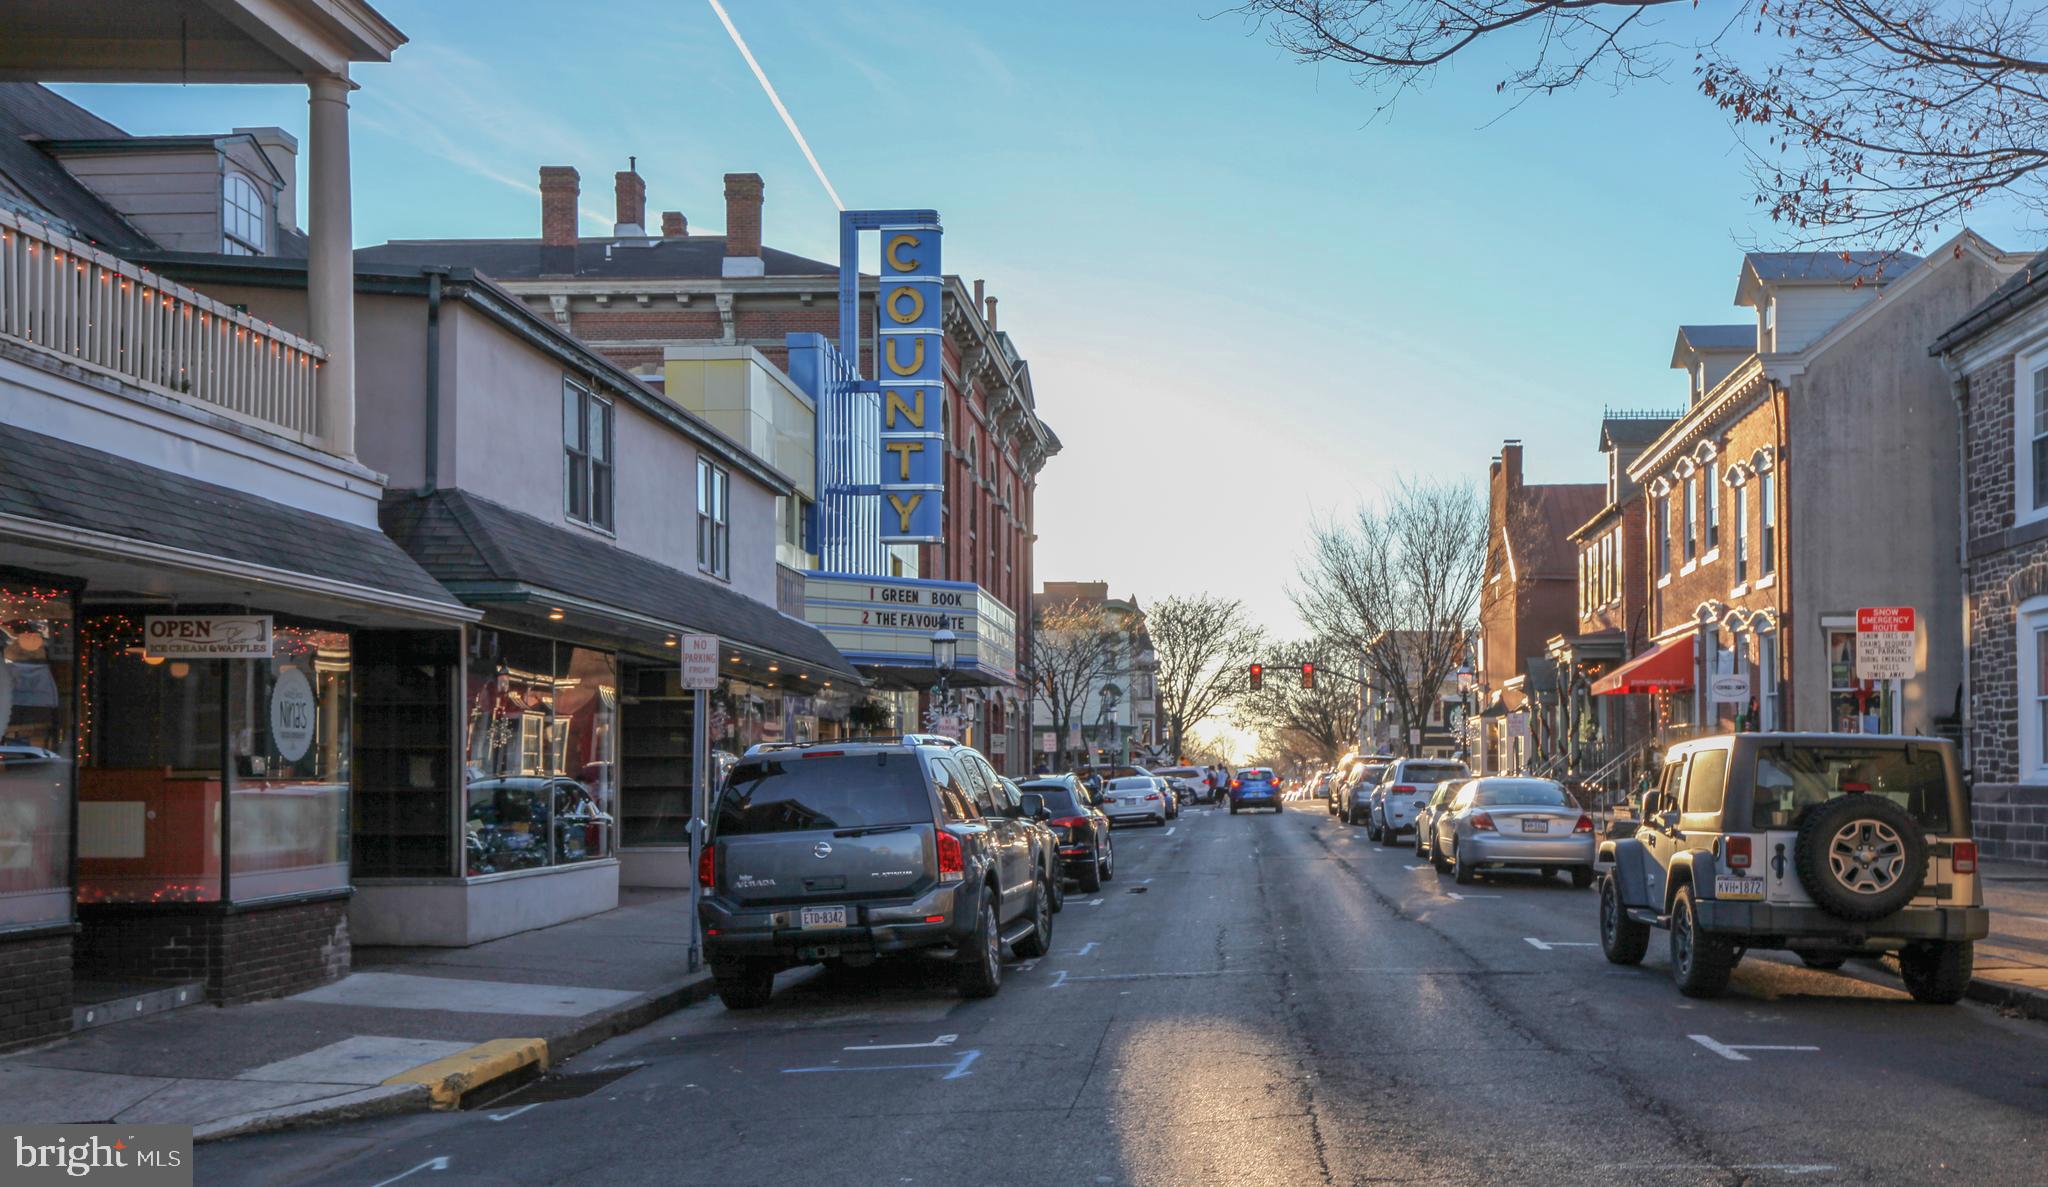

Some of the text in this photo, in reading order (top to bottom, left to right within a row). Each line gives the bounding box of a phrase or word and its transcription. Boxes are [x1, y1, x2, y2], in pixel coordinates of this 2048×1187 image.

[885, 233, 925, 533] COUNTY
[881, 588, 919, 604] GREEN
[931, 592, 962, 606] BOOK
[1873, 608, 1899, 616] SNOW
[862, 611, 965, 630] 2 THE FAVOUITE
[1862, 616, 1910, 624] EMERGENCY
[150, 620, 212, 638] OPEN
[151, 644, 168, 653] ICE
[169, 644, 207, 653] CREAM
[218, 644, 267, 653] WAFFLES
[693, 639, 707, 650] NO
[1860, 640, 1912, 648] CHAINS REQUIRED
[684, 653, 716, 664] PARKING
